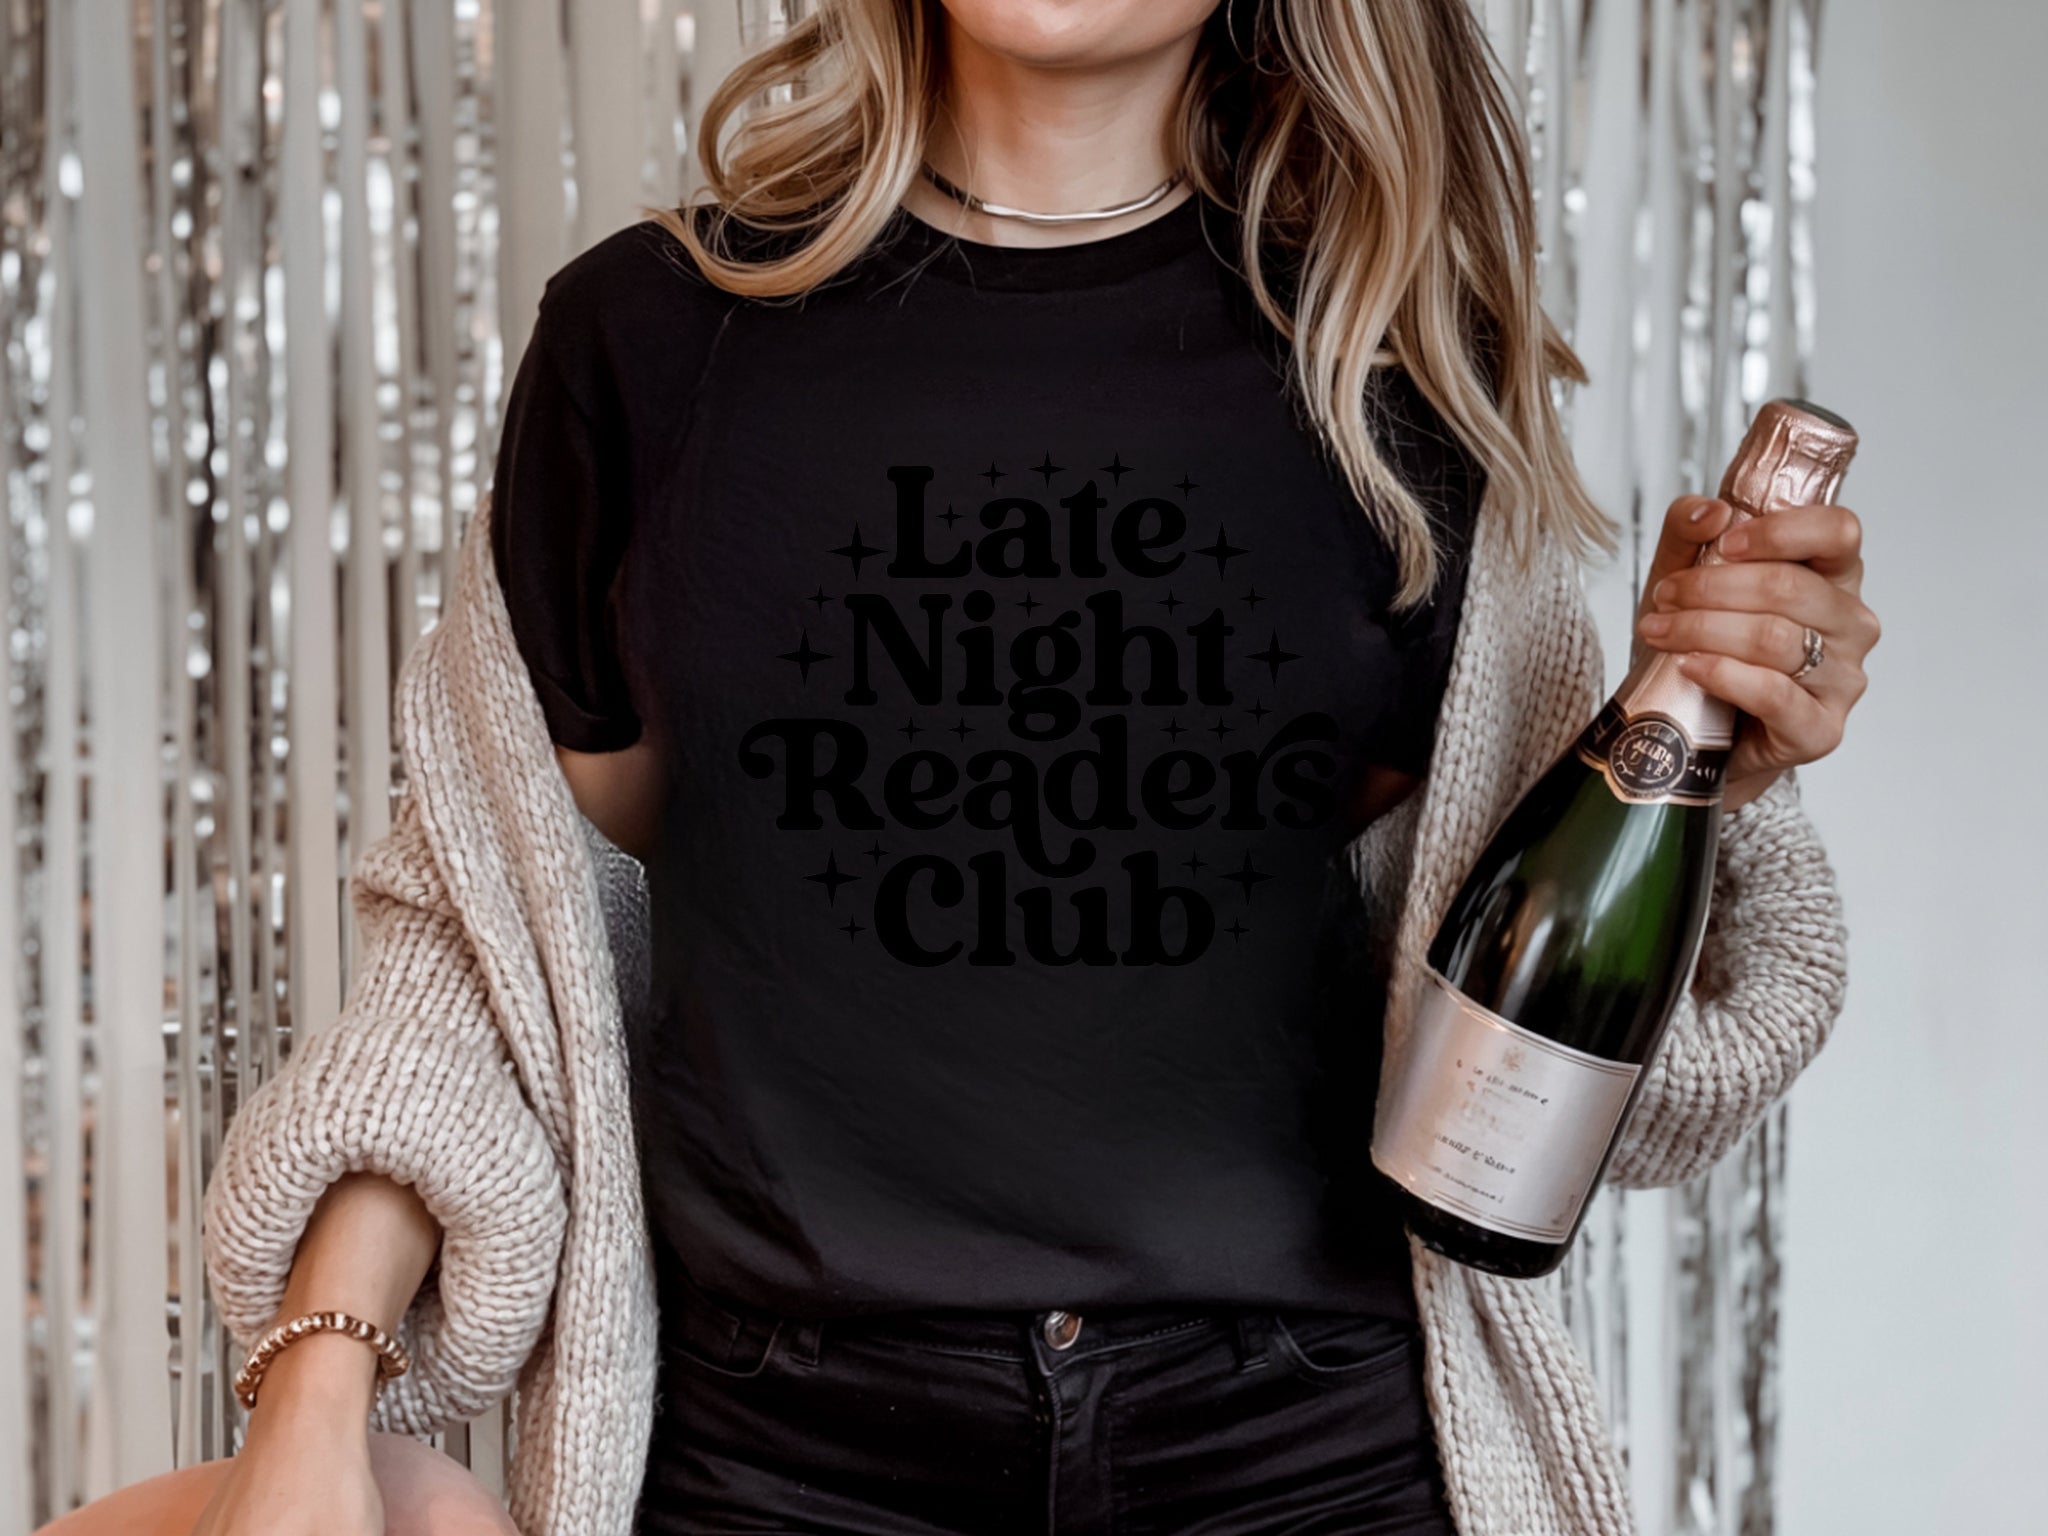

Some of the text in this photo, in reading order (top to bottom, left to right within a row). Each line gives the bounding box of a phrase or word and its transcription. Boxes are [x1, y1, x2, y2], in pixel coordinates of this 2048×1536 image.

[887, 465, 1188, 579] Late
[844, 589, 1235, 742] Night
[738, 711, 1341, 879] Readers
[873, 848, 1216, 968] Club
